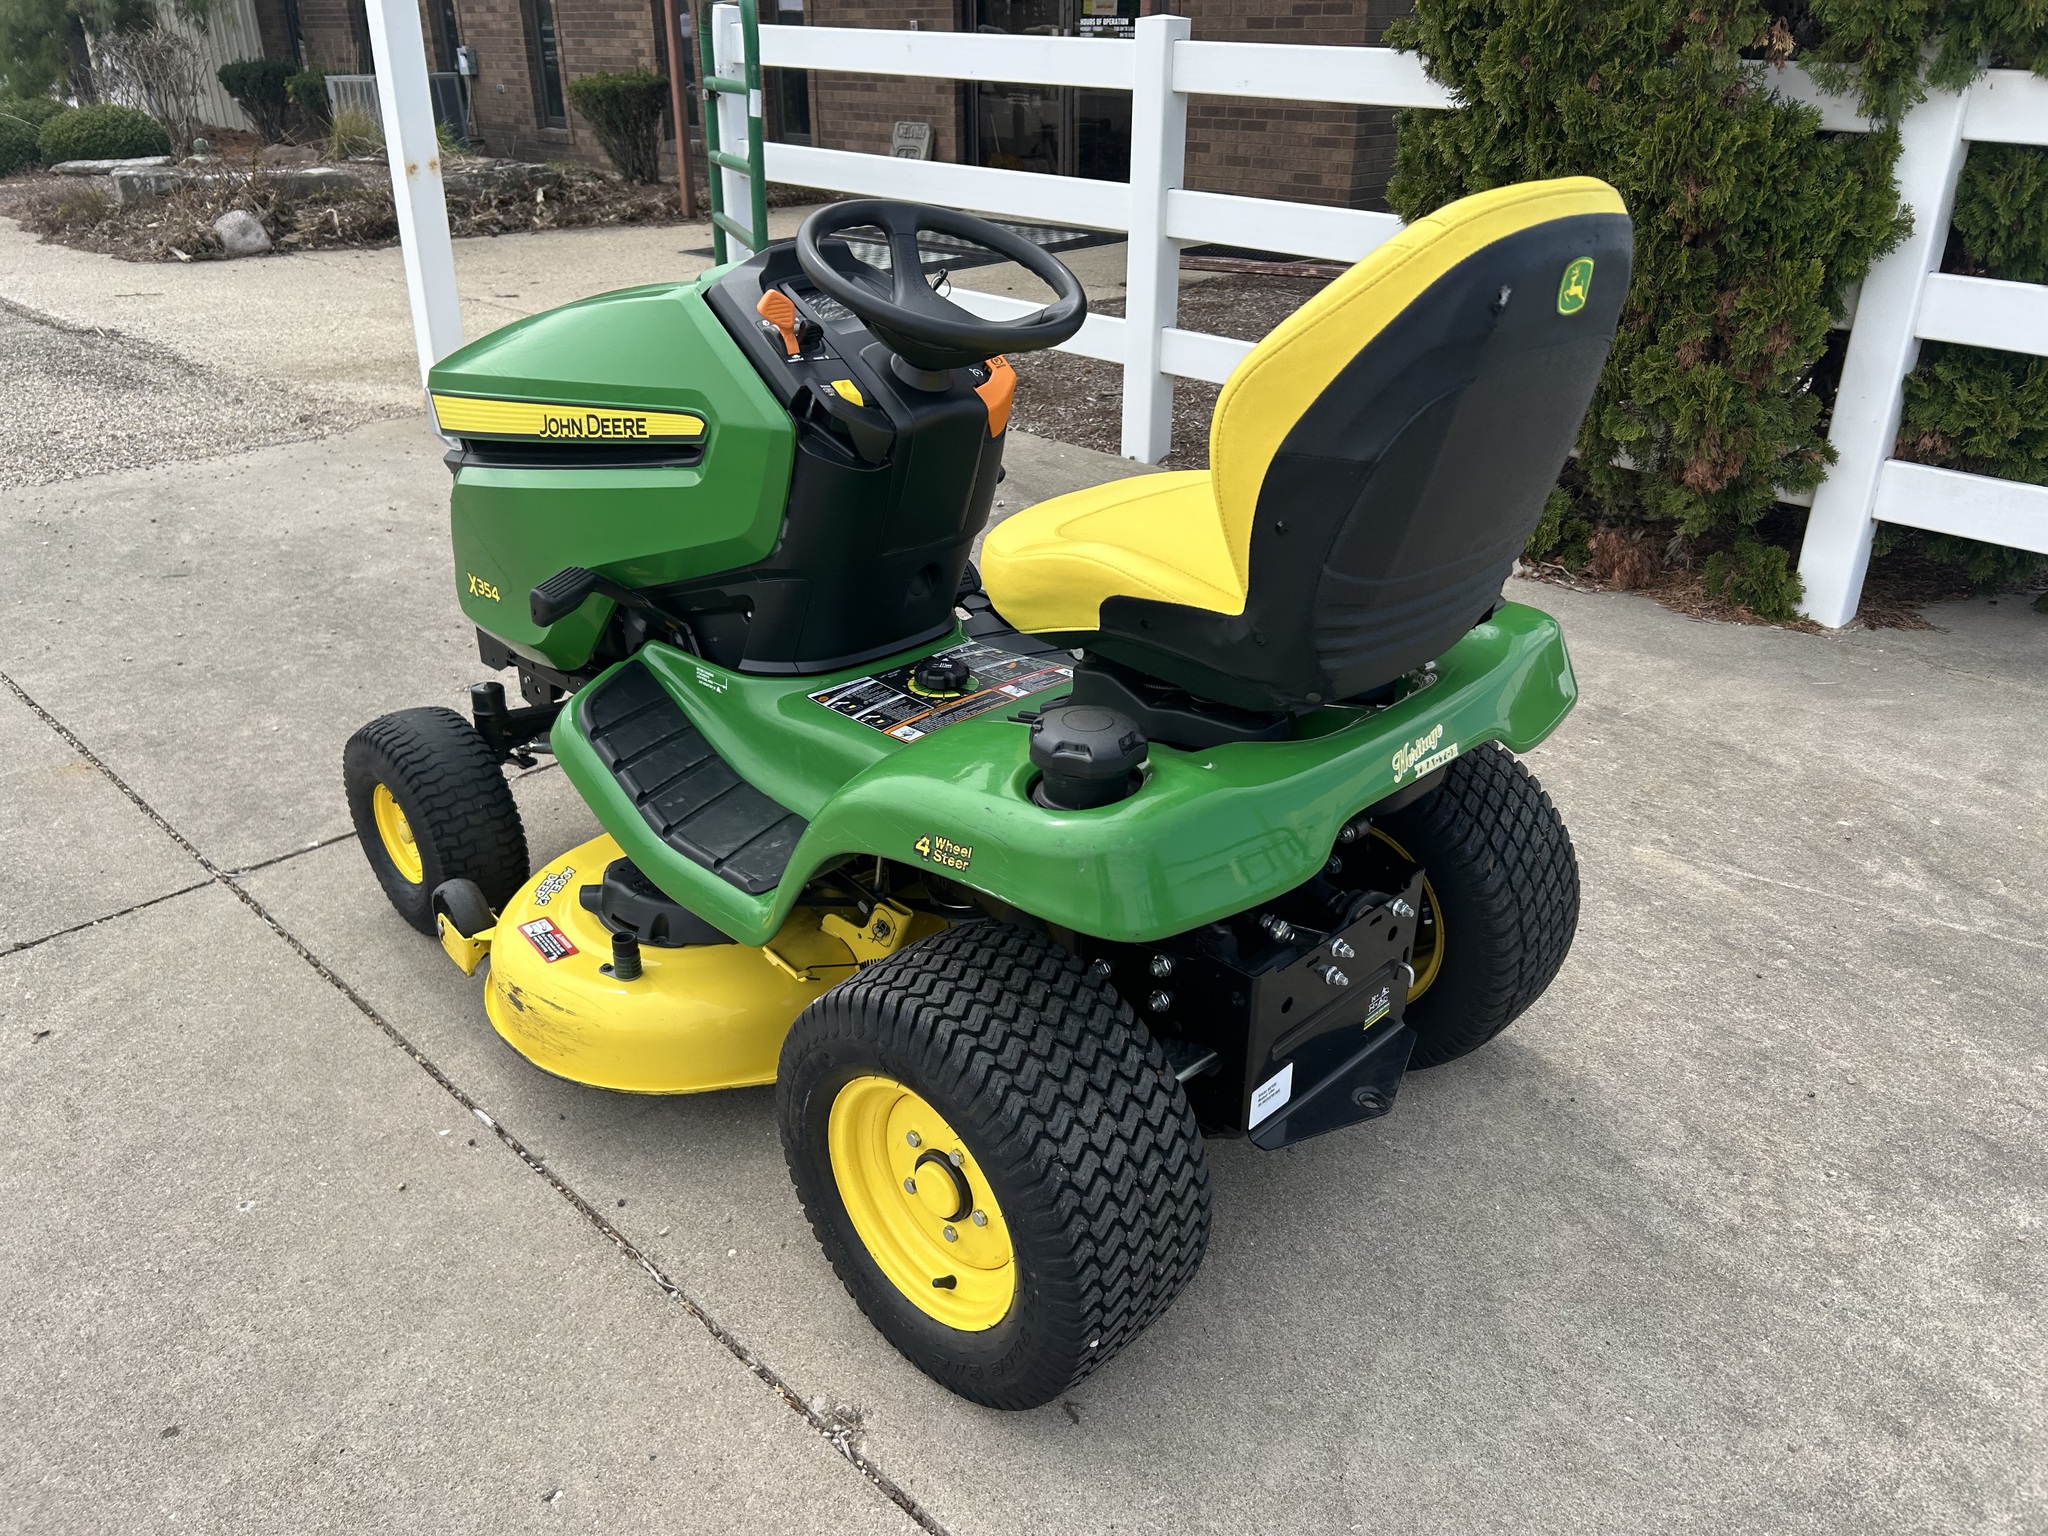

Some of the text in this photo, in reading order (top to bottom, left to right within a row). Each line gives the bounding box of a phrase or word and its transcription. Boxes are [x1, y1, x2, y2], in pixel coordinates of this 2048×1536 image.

[1096, 18, 1102, 26] OF
[539, 414, 649, 438] JOHN DEERE
[467, 573, 501, 603] X354
[915, 836, 973, 859] 4 Wheel
[933, 849, 970, 871] Steer
[535, 873, 558, 898] DEEP
[548, 866, 576, 895] ACCEL
